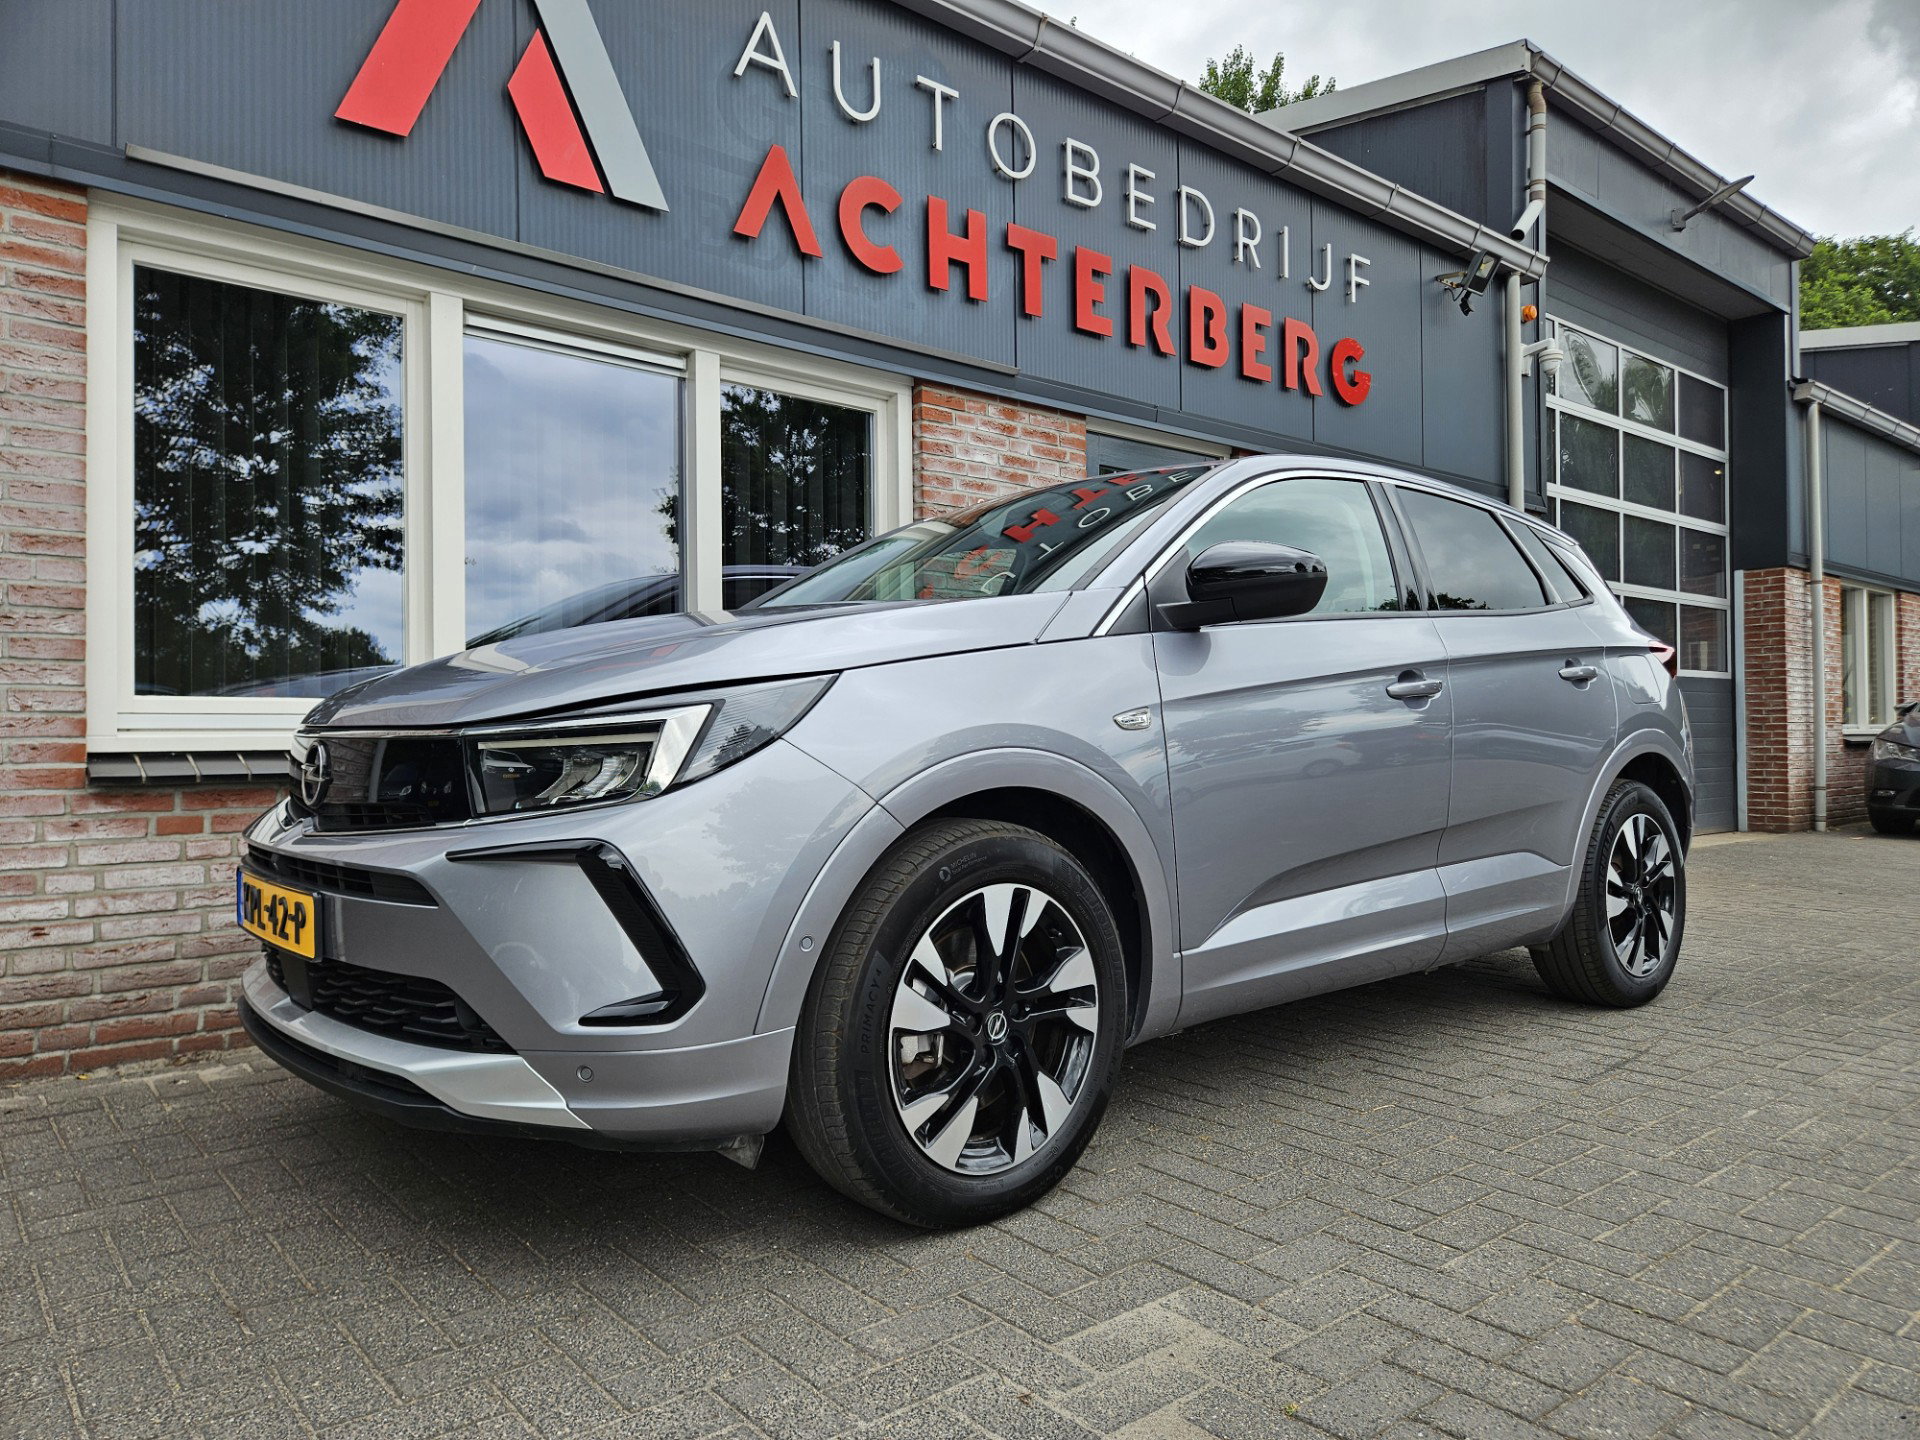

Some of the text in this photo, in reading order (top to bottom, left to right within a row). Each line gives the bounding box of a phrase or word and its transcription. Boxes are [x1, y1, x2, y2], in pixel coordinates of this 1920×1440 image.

[733, 10, 1371, 303] AUTOBEDRIJF
[733, 144, 1372, 406] ACHTERBERG
[860, 977, 880, 1054] PRIMACY
